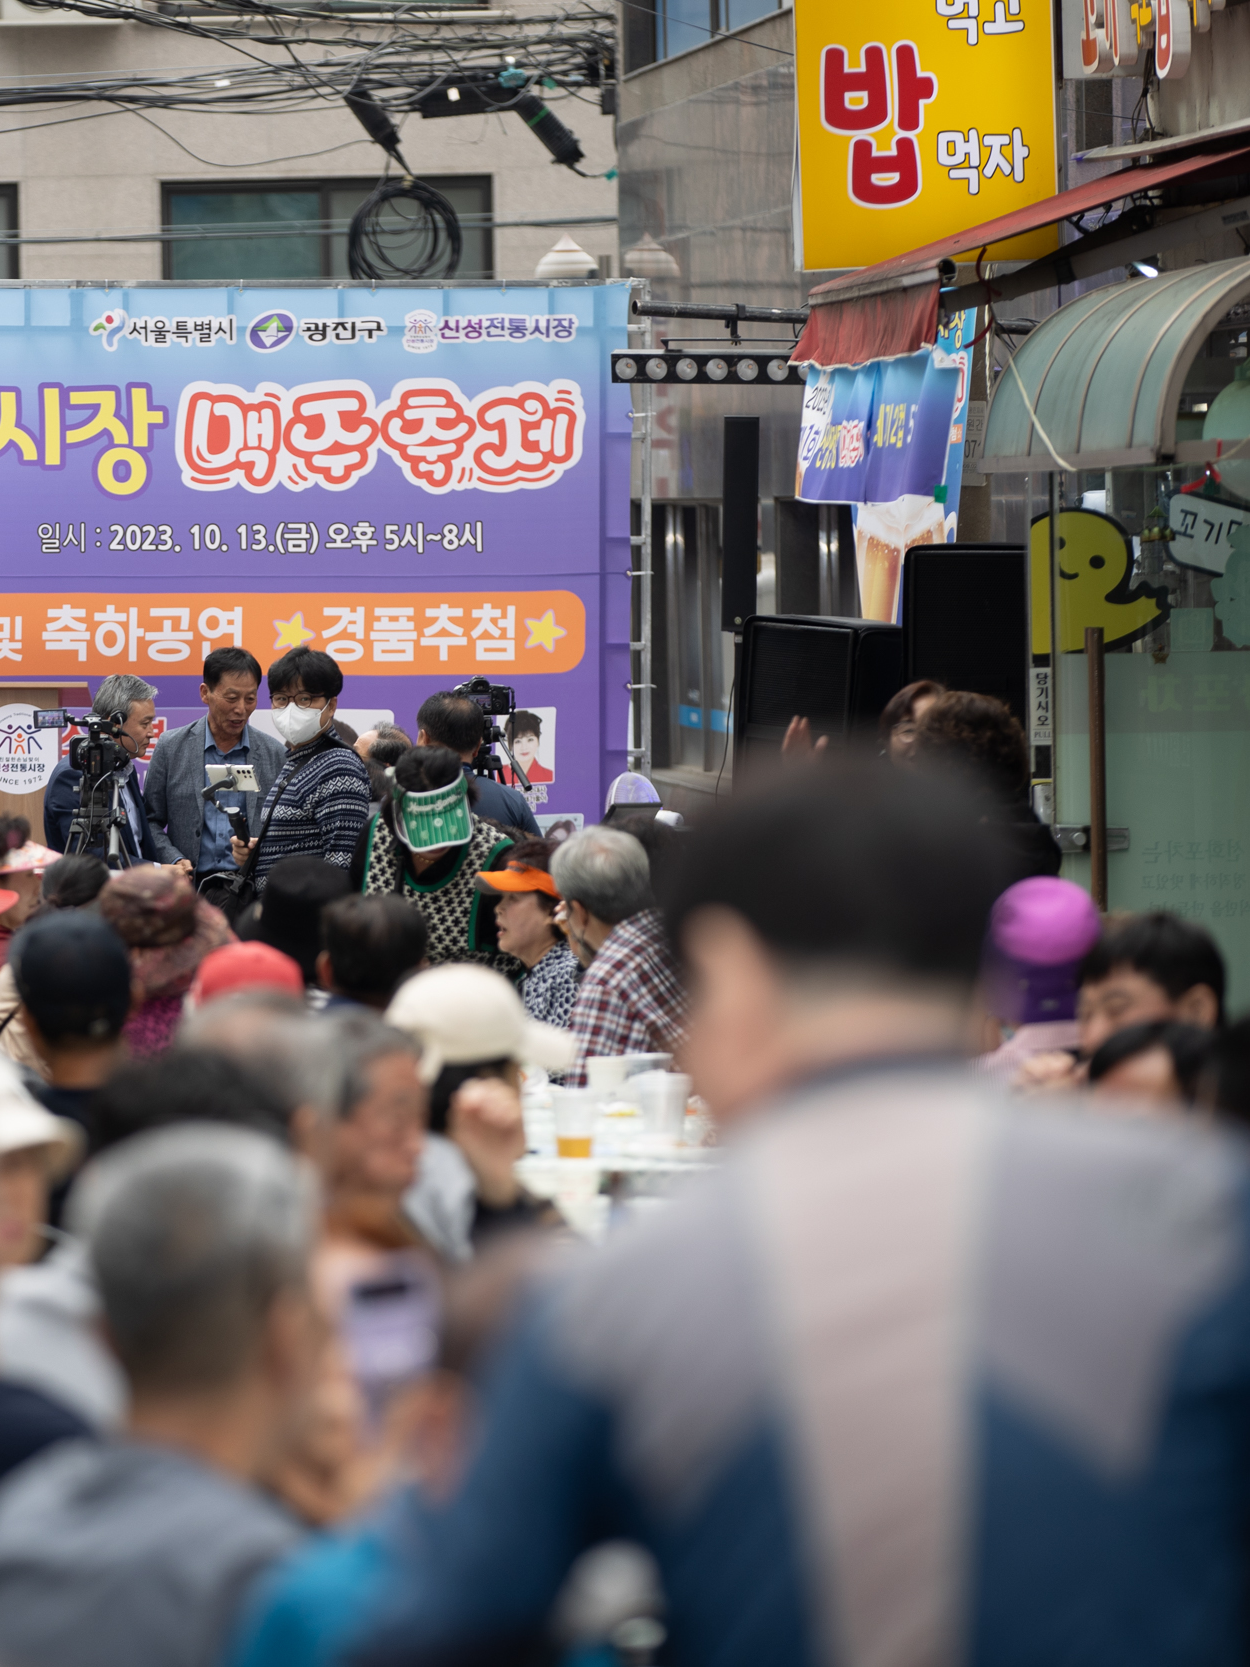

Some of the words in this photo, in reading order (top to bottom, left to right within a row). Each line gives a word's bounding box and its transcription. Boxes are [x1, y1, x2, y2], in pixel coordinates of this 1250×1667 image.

[822, 42, 936, 207] 밥
[937, 128, 1030, 195] 먹자
[129, 317, 235, 344] 서울특별시
[301, 319, 385, 343] 광진구
[439, 317, 575, 340] 신성전통시장
[183, 385, 580, 488] 맥주축제
[37, 522, 86, 553] 일시
[108, 523, 182, 552] 2023.
[190, 523, 228, 552] 10.
[325, 522, 378, 553] 오후
[383, 522, 485, 554] 5시~8시
[42, 603, 244, 662] 축하공연
[321, 603, 517, 662] 경품추첨
[1035, 672, 1050, 727] 당기시오
[23, 774, 43, 786] 1972
